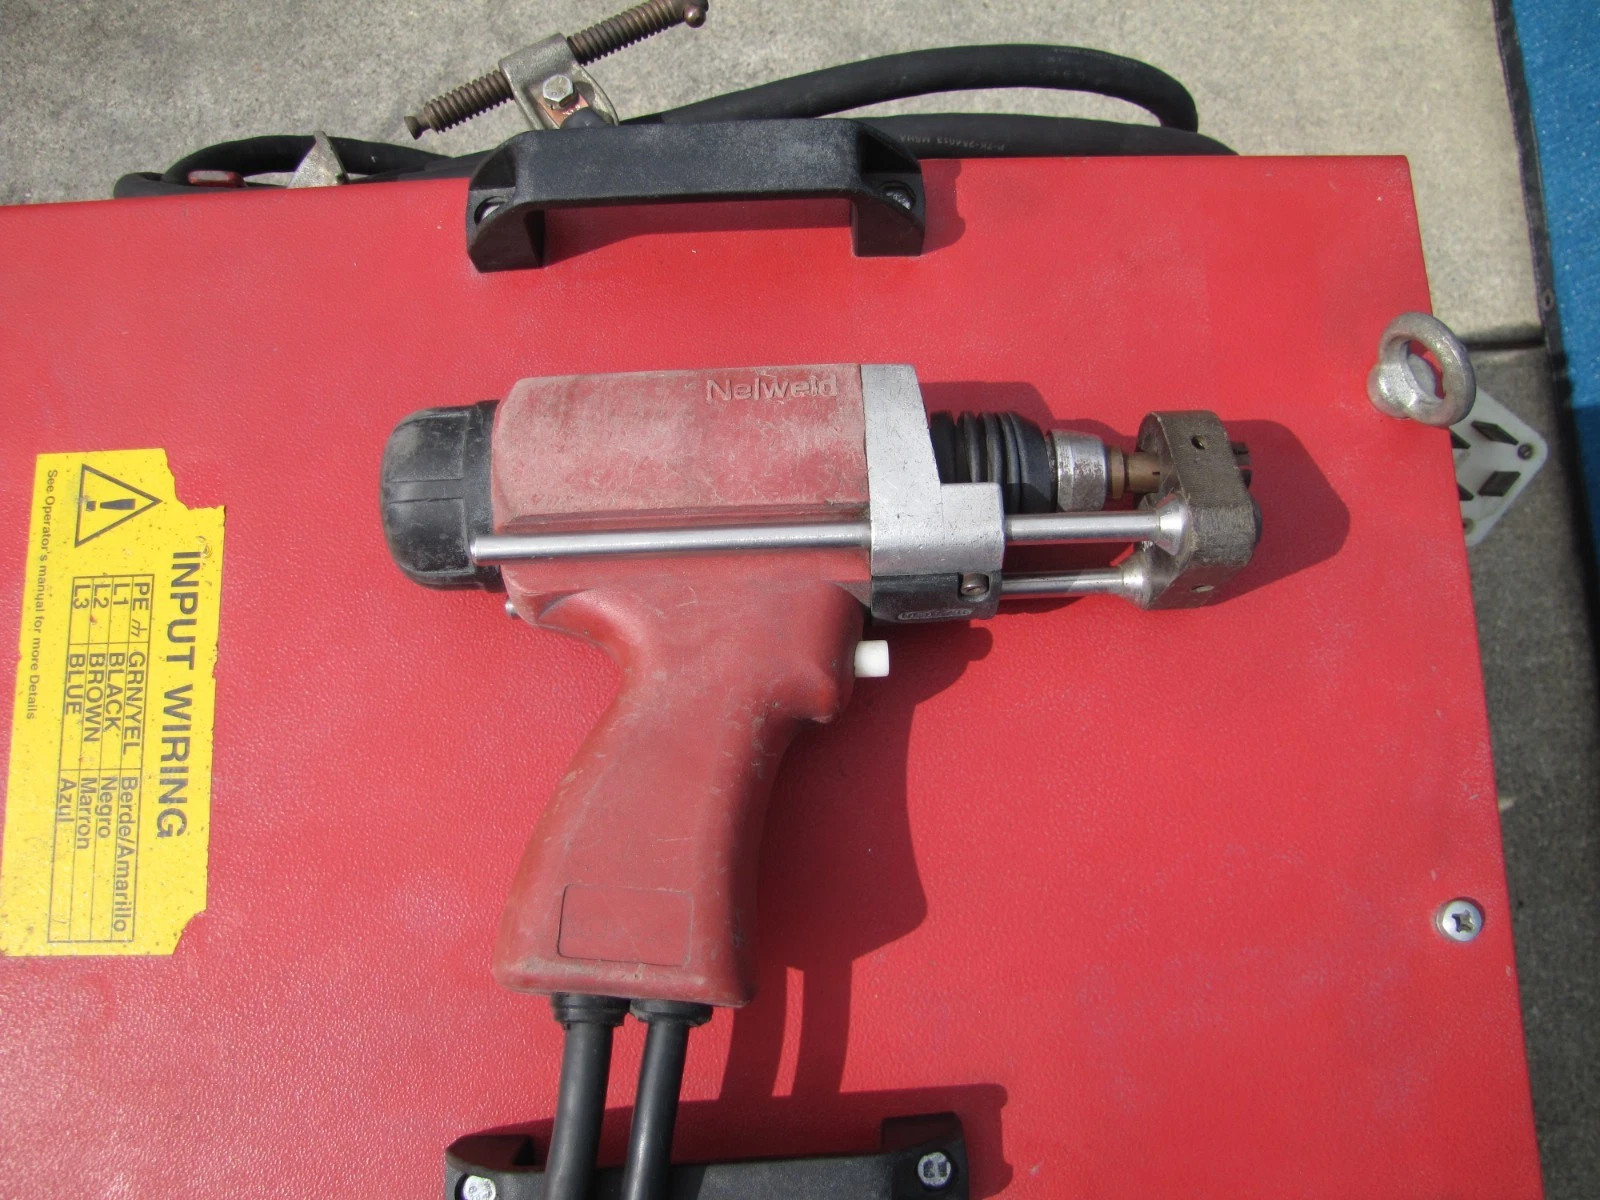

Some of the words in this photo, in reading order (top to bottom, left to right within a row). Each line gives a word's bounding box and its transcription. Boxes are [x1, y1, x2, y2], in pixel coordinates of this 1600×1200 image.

[705, 374, 838, 402] Nelweld
[46, 469, 58, 493] See
[40, 495, 56, 562] Operator's
[34, 565, 48, 612] manual
[72, 584, 92, 610] L3
[92, 583, 111, 609] L2
[112, 582, 130, 607] L1
[132, 582, 151, 611] PE
[166, 551, 202, 670] INPUT
[33, 616, 45, 634] for
[30, 638, 41, 671] more
[26, 674, 41, 720] Details
[65, 653, 86, 715] BLUE
[83, 652, 106, 742] BROWN
[103, 652, 126, 732] BLACK
[123, 651, 146, 755] GRN/YEL
[156, 684, 194, 838] WIRING
[56, 778, 77, 823] Azul
[76, 777, 98, 850] Marron
[94, 776, 118, 839] Negro
[113, 776, 139, 932] Berde/Amarillo
